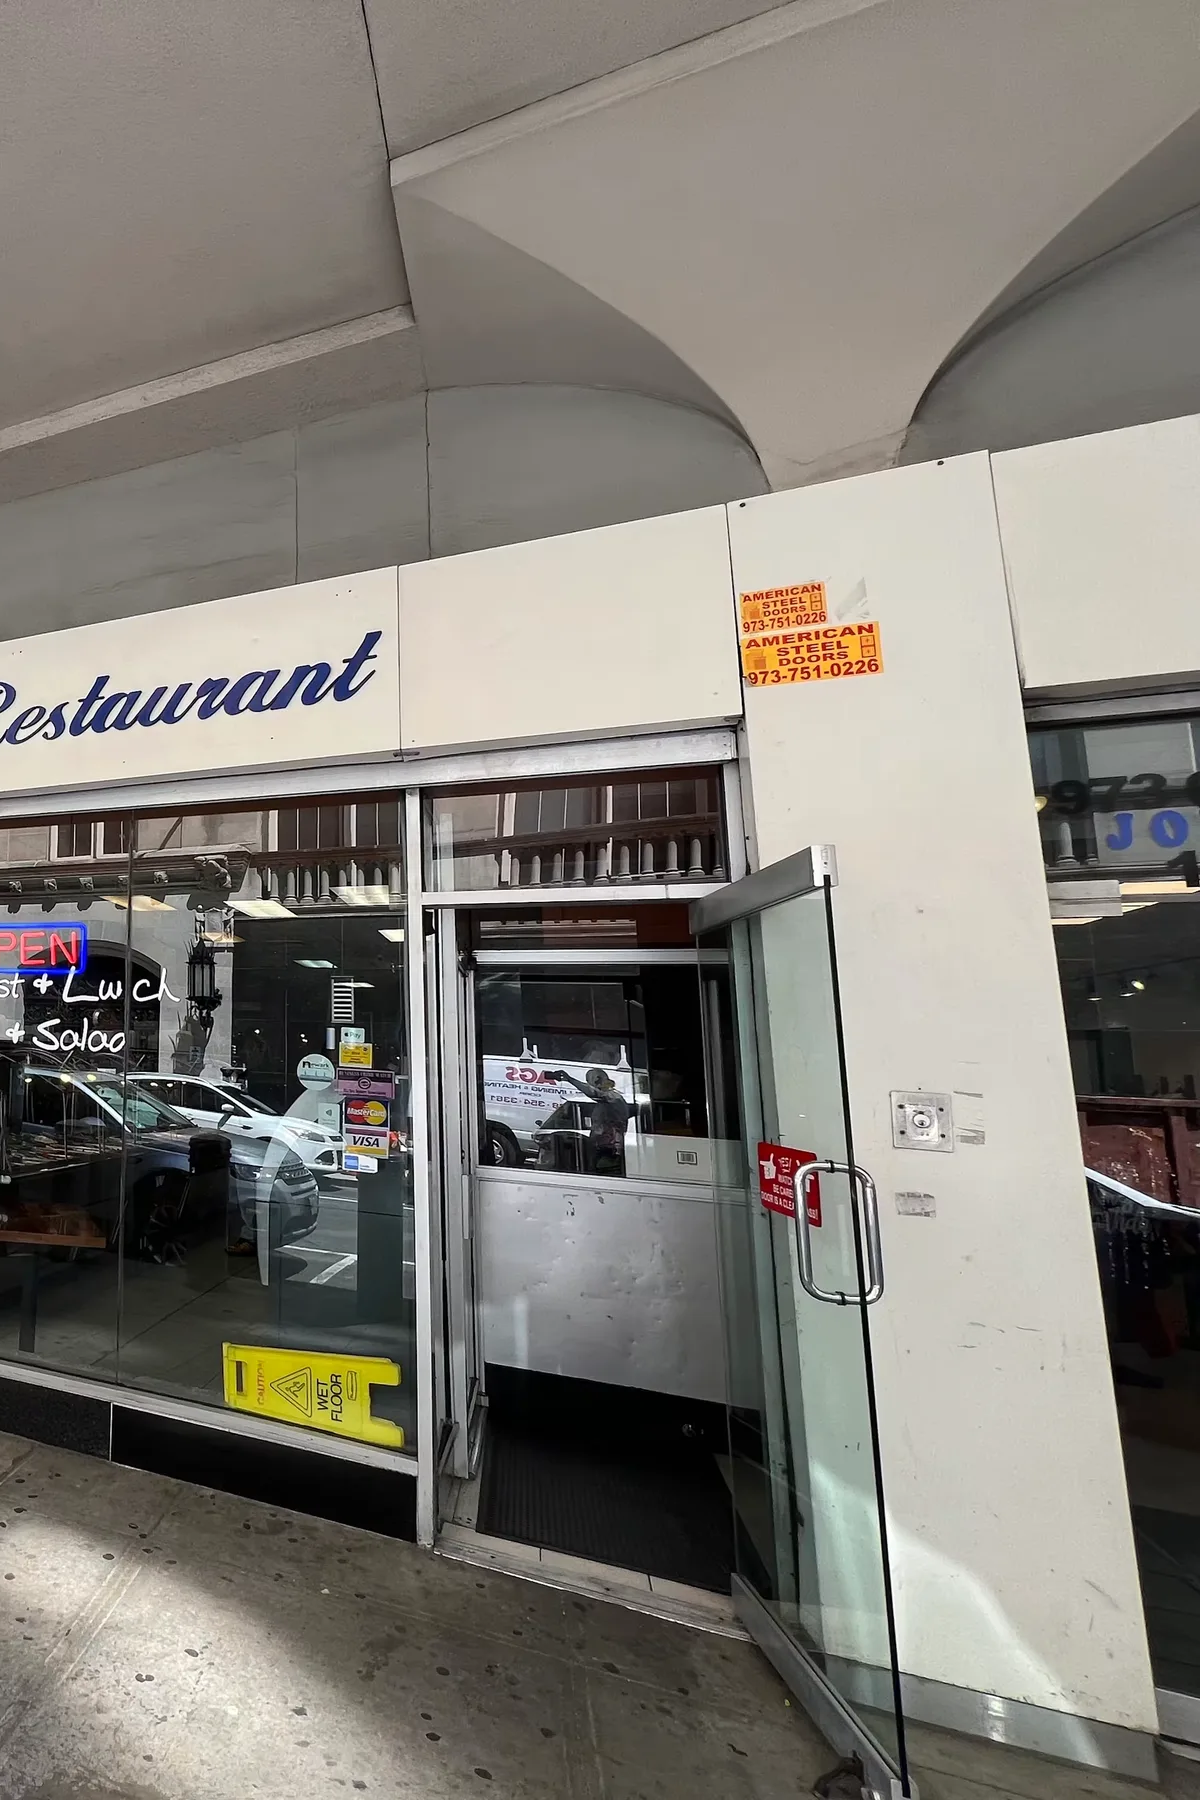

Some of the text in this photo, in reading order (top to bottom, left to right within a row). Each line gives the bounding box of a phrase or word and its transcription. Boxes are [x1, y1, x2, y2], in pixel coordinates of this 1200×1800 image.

[743, 584, 821, 603] AMERICAN
[762, 597, 806, 609] STEEL
[763, 605, 806, 617] DOORS
[743, 611, 826, 633] 973-751-0226
[745, 624, 874, 649] AMERICAN
[776, 640, 849, 656] STEEL
[778, 651, 849, 666] DOORS
[748, 659, 879, 684] 973-751-0226
[350, 1031, 361, 1039] Pay
[347, 1107, 386, 1117] MasterCard
[352, 1136, 379, 1147] VISA
[316, 1379, 328, 1411] WET
[331, 1373, 343, 1423] FLOOR
